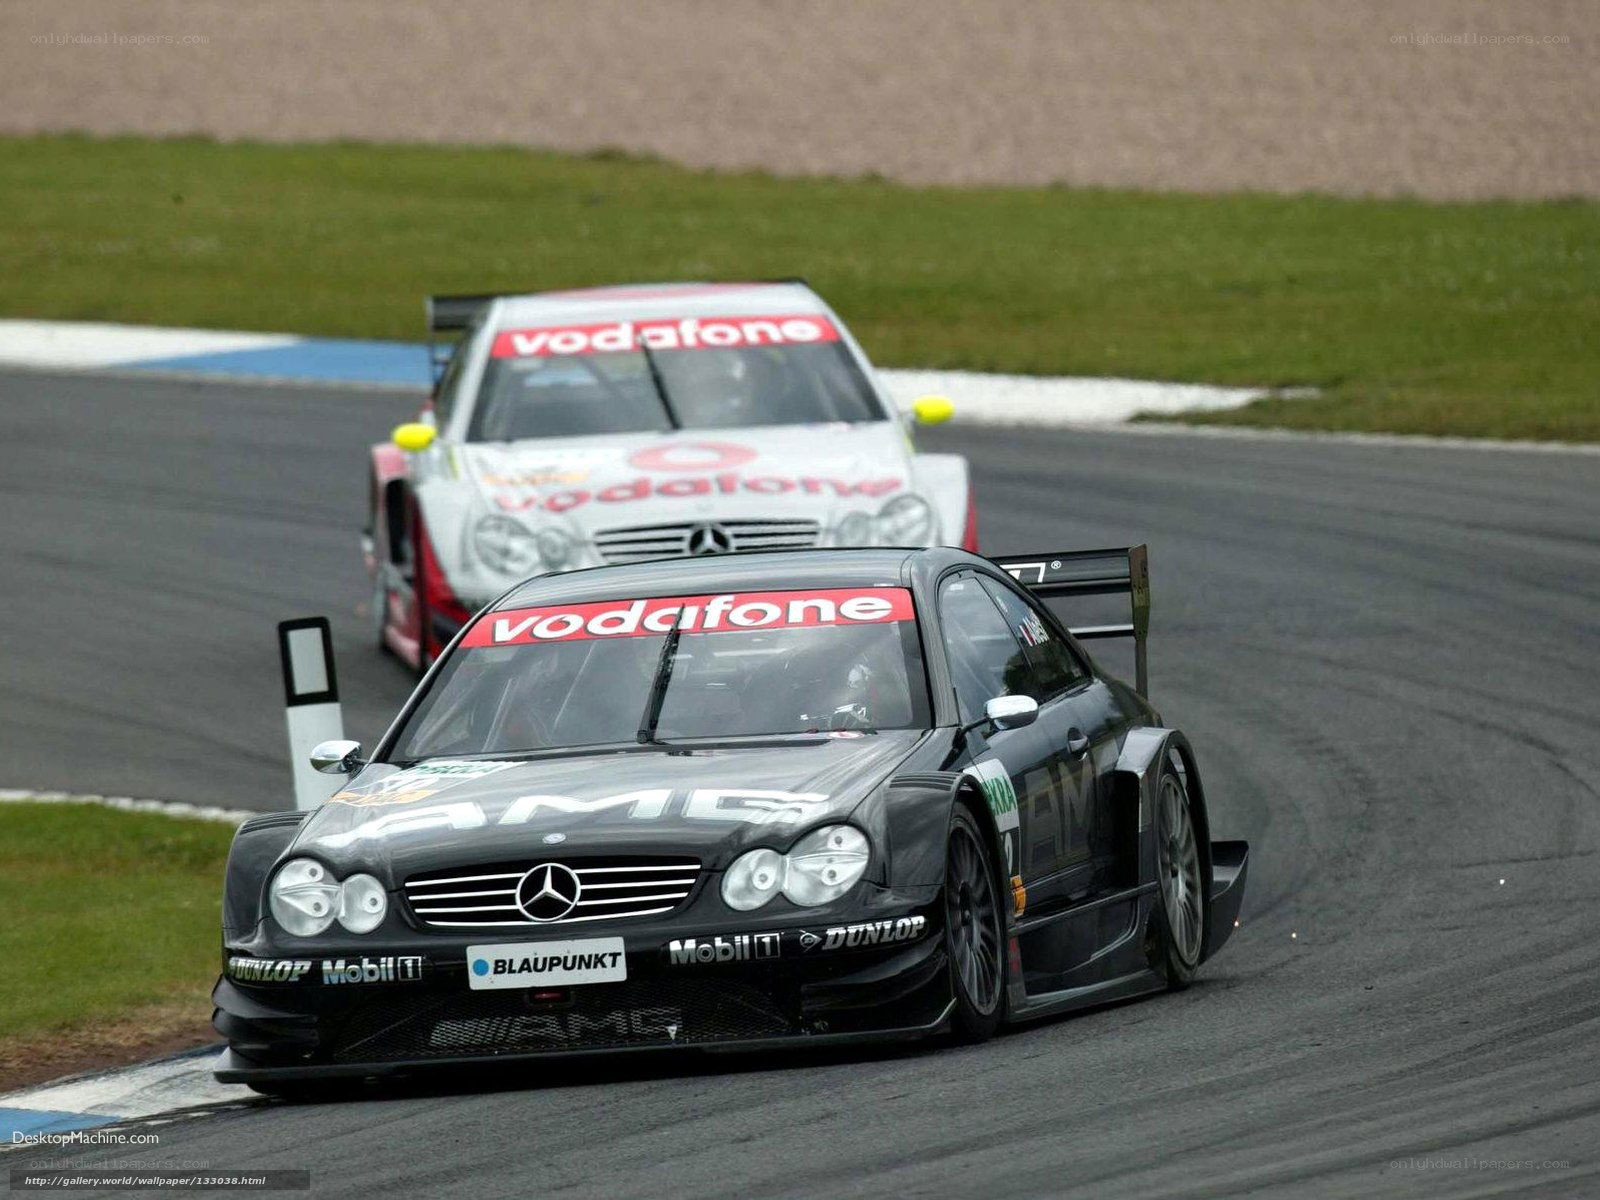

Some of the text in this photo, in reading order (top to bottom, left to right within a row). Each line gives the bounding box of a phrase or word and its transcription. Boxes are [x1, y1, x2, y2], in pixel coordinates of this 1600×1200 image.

[511, 318, 823, 356] vodafone
[495, 472, 903, 512] vodafone
[493, 594, 893, 644] vodafone
[317, 788, 831, 847] AMG
[669, 935, 750, 965] Mobil
[822, 915, 928, 951] DUNLOP
[236, 958, 311, 983] DUNLOP
[322, 957, 395, 985] Mobil
[493, 951, 622, 976] BLAUPUNKT
